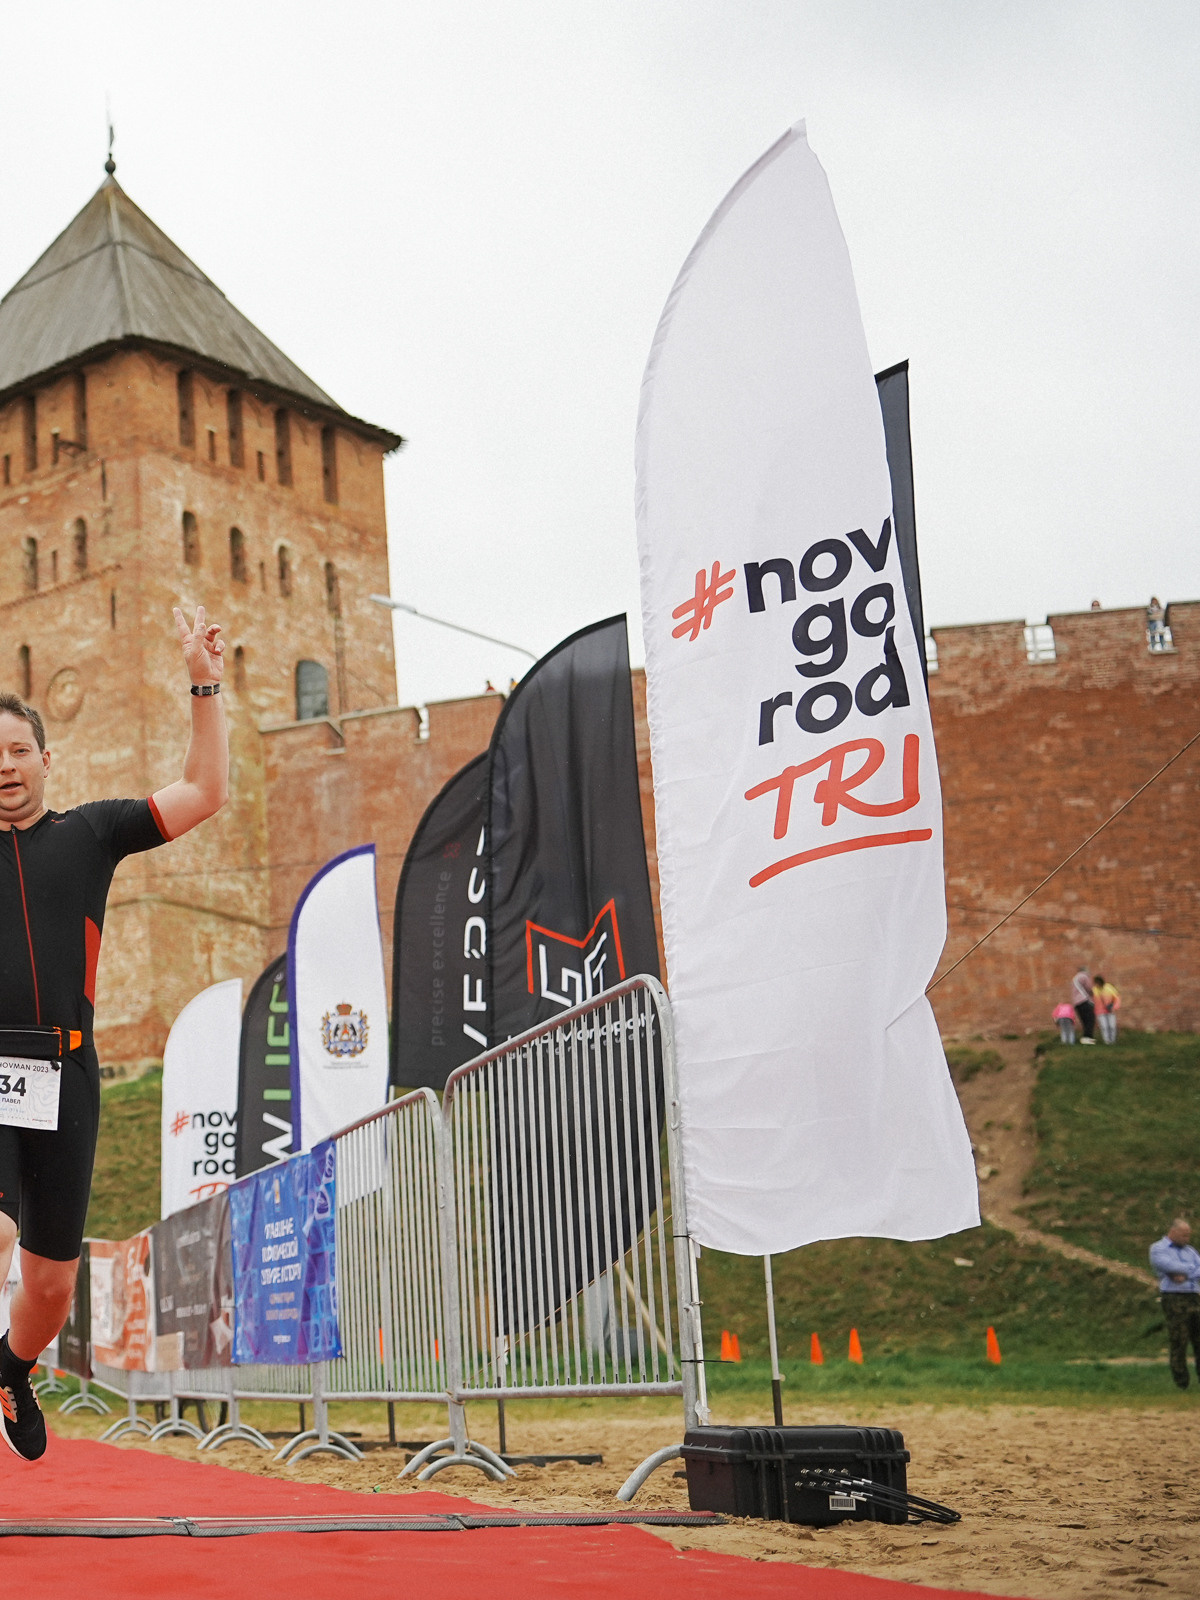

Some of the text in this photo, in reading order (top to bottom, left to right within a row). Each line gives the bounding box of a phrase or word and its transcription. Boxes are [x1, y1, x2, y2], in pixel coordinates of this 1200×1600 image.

[671, 516, 892, 642] #nov
[792, 582, 896, 678] go
[758, 625, 910, 746] rod
[744, 733, 920, 839] TRI
[1, 1097, 21, 1105] ПАВЕЛ
[32, 1065, 49, 1073] 2023
